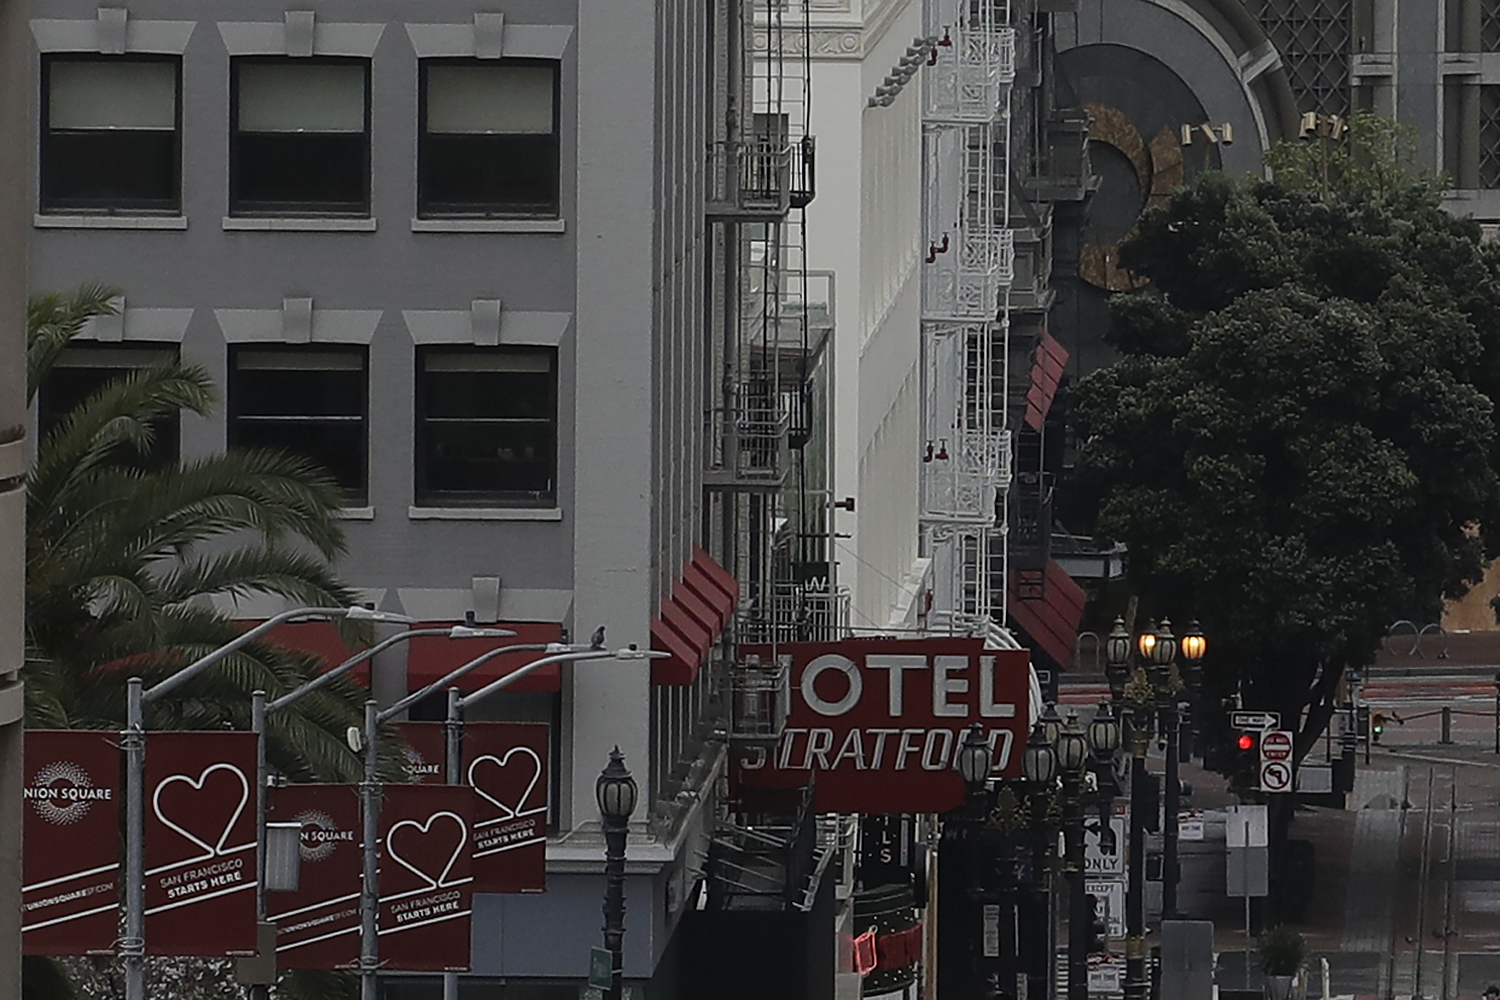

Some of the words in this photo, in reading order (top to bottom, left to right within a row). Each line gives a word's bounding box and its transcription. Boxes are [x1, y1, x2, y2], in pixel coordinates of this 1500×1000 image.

[405, 763, 440, 776] QUARE
[23, 786, 58, 800] NION
[60, 786, 112, 801] SQUARE
[311, 830, 354, 842] SQUARE
[159, 872, 183, 889] SAN
[183, 857, 244, 883] FRANCISCO
[167, 877, 209, 900] STARTS
[210, 870, 243, 888] HERE
[396, 907, 431, 924] STARTS
[432, 901, 460, 916] HERE
